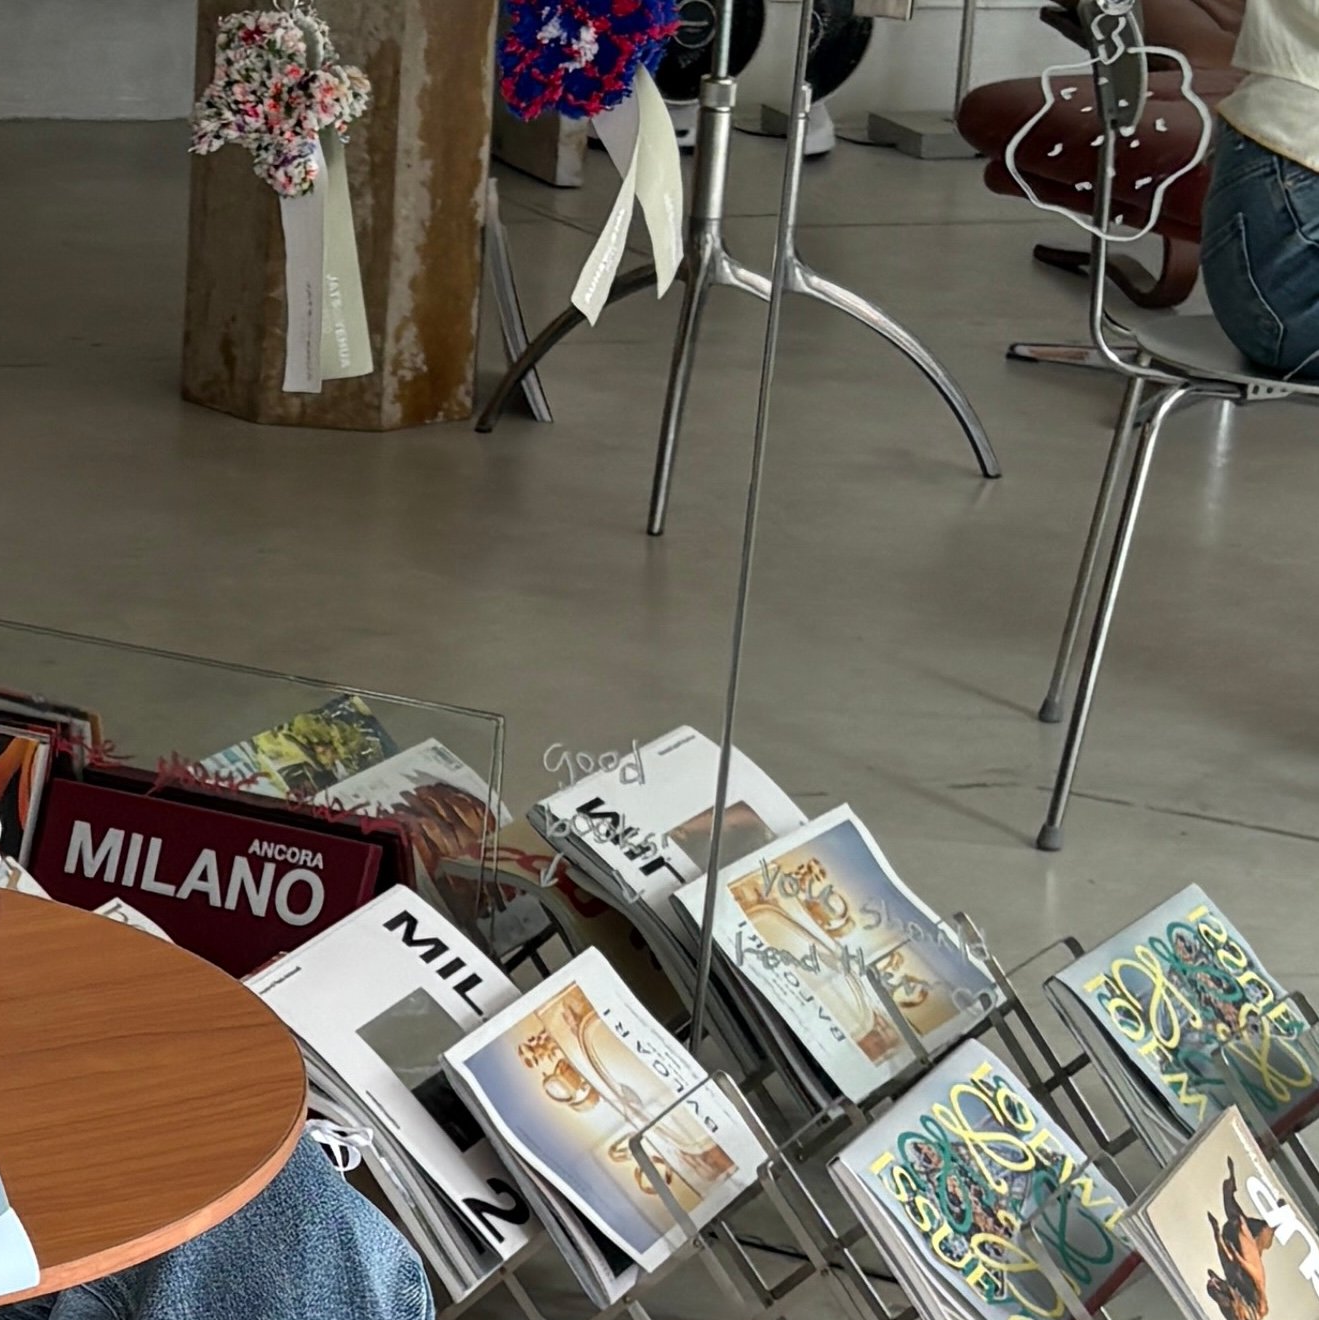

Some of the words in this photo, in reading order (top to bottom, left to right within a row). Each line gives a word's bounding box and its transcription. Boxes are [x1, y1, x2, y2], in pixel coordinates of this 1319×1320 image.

[64, 820, 325, 926] MILANO
[248, 838, 324, 870] ANCORA
[382, 910, 488, 1024] MIL
[462, 1177, 531, 1244] 2
[870, 1154, 1015, 1302] ISSUE
